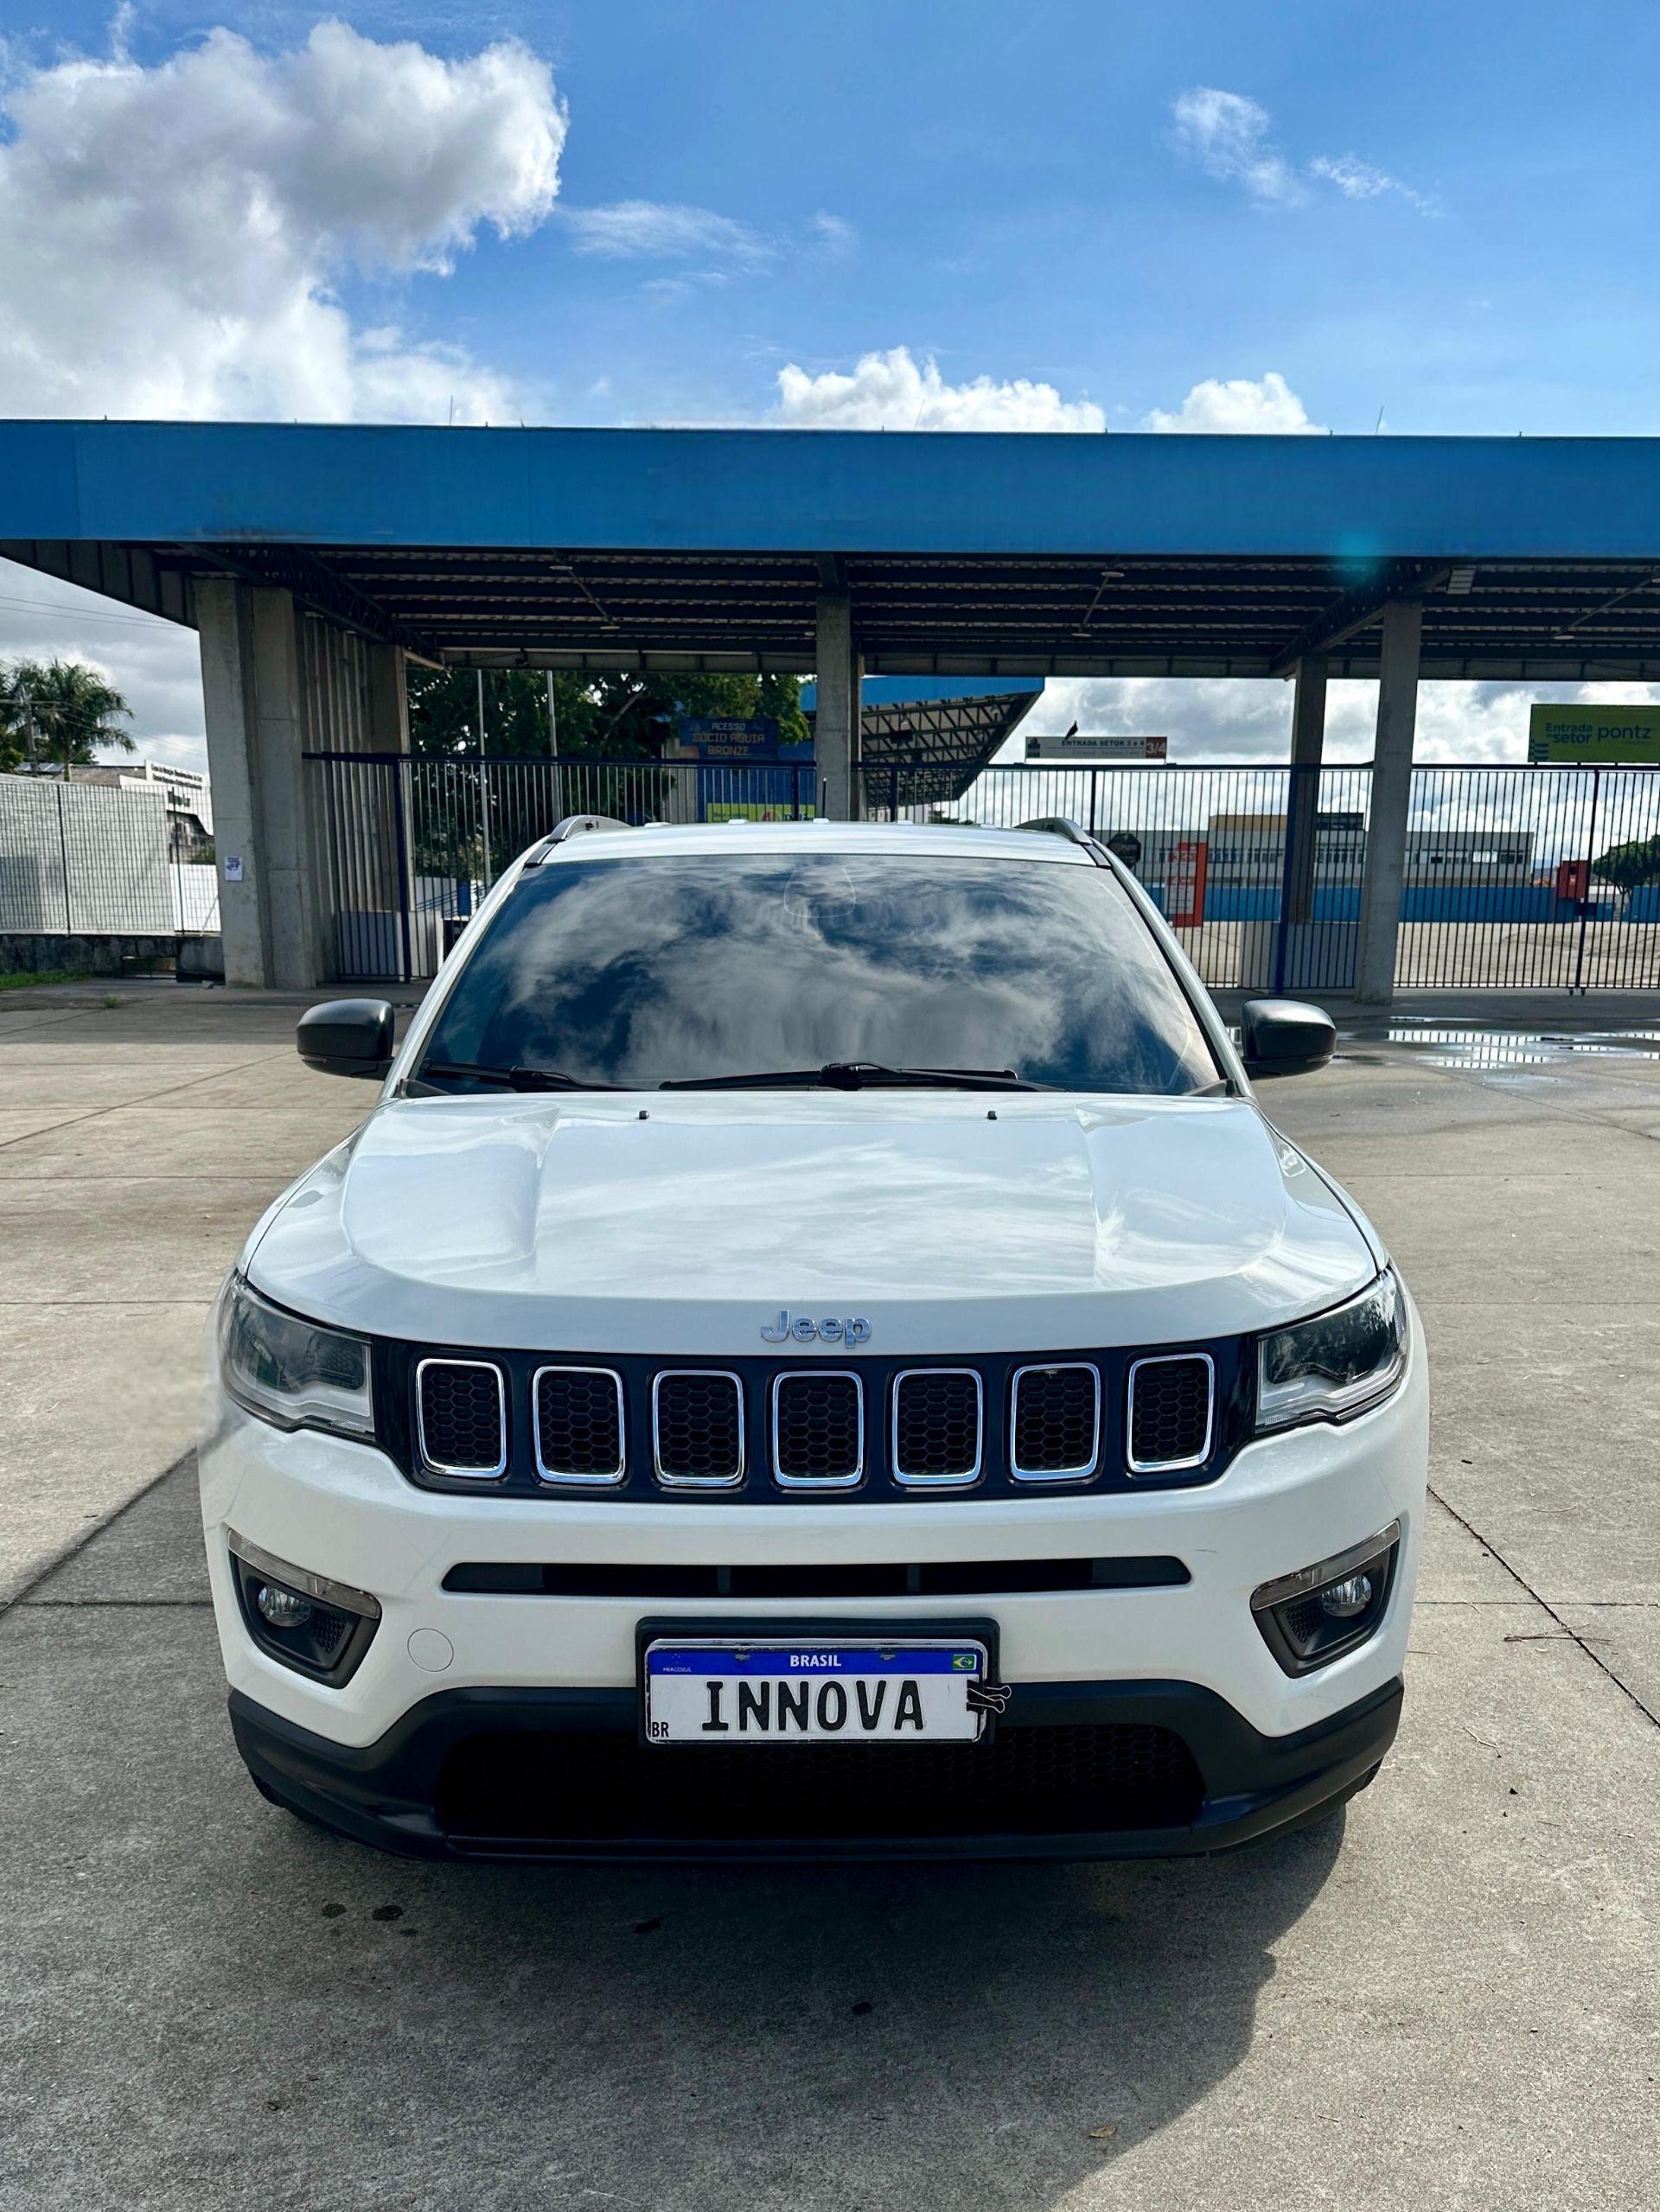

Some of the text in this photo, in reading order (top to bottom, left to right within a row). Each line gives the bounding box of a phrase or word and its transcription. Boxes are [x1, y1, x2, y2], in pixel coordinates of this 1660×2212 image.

[712, 723, 745, 731] ACESSO
[1545, 723, 1593, 733] Entrada
[1553, 733, 1593, 743] setor
[1598, 725, 1651, 743] pontz
[707, 745, 750, 755] BRONZE
[1146, 742, 1166, 755] 3/4
[760, 1310, 872, 1348] Jeep
[789, 1654, 842, 1667] BRASIL
[702, 1680, 924, 1731] INNOVA
[651, 1721, 669, 1738] BR
